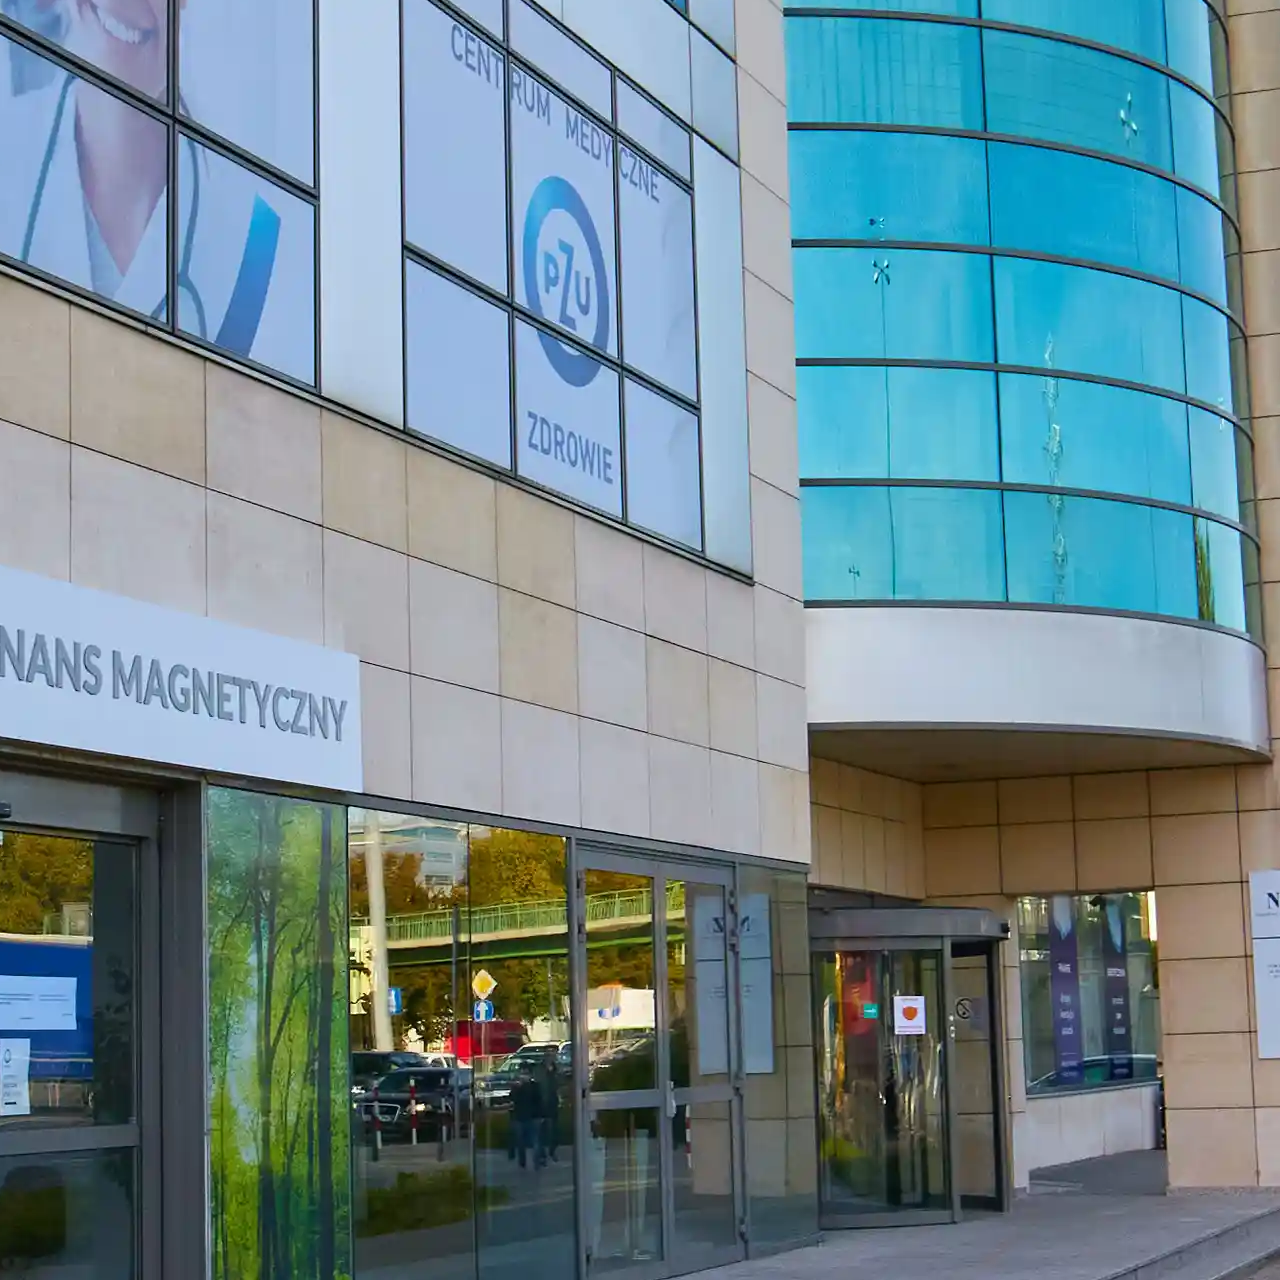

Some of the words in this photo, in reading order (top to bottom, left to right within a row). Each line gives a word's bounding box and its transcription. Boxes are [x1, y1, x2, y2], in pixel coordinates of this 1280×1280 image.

[450, 23, 552, 127] CENTRUM
[565, 112, 661, 204] MEDYCZNE
[543, 237, 592, 332] PZU
[526, 410, 614, 486] ZDROWIE
[111, 651, 348, 744] MAGNETYCZNY
